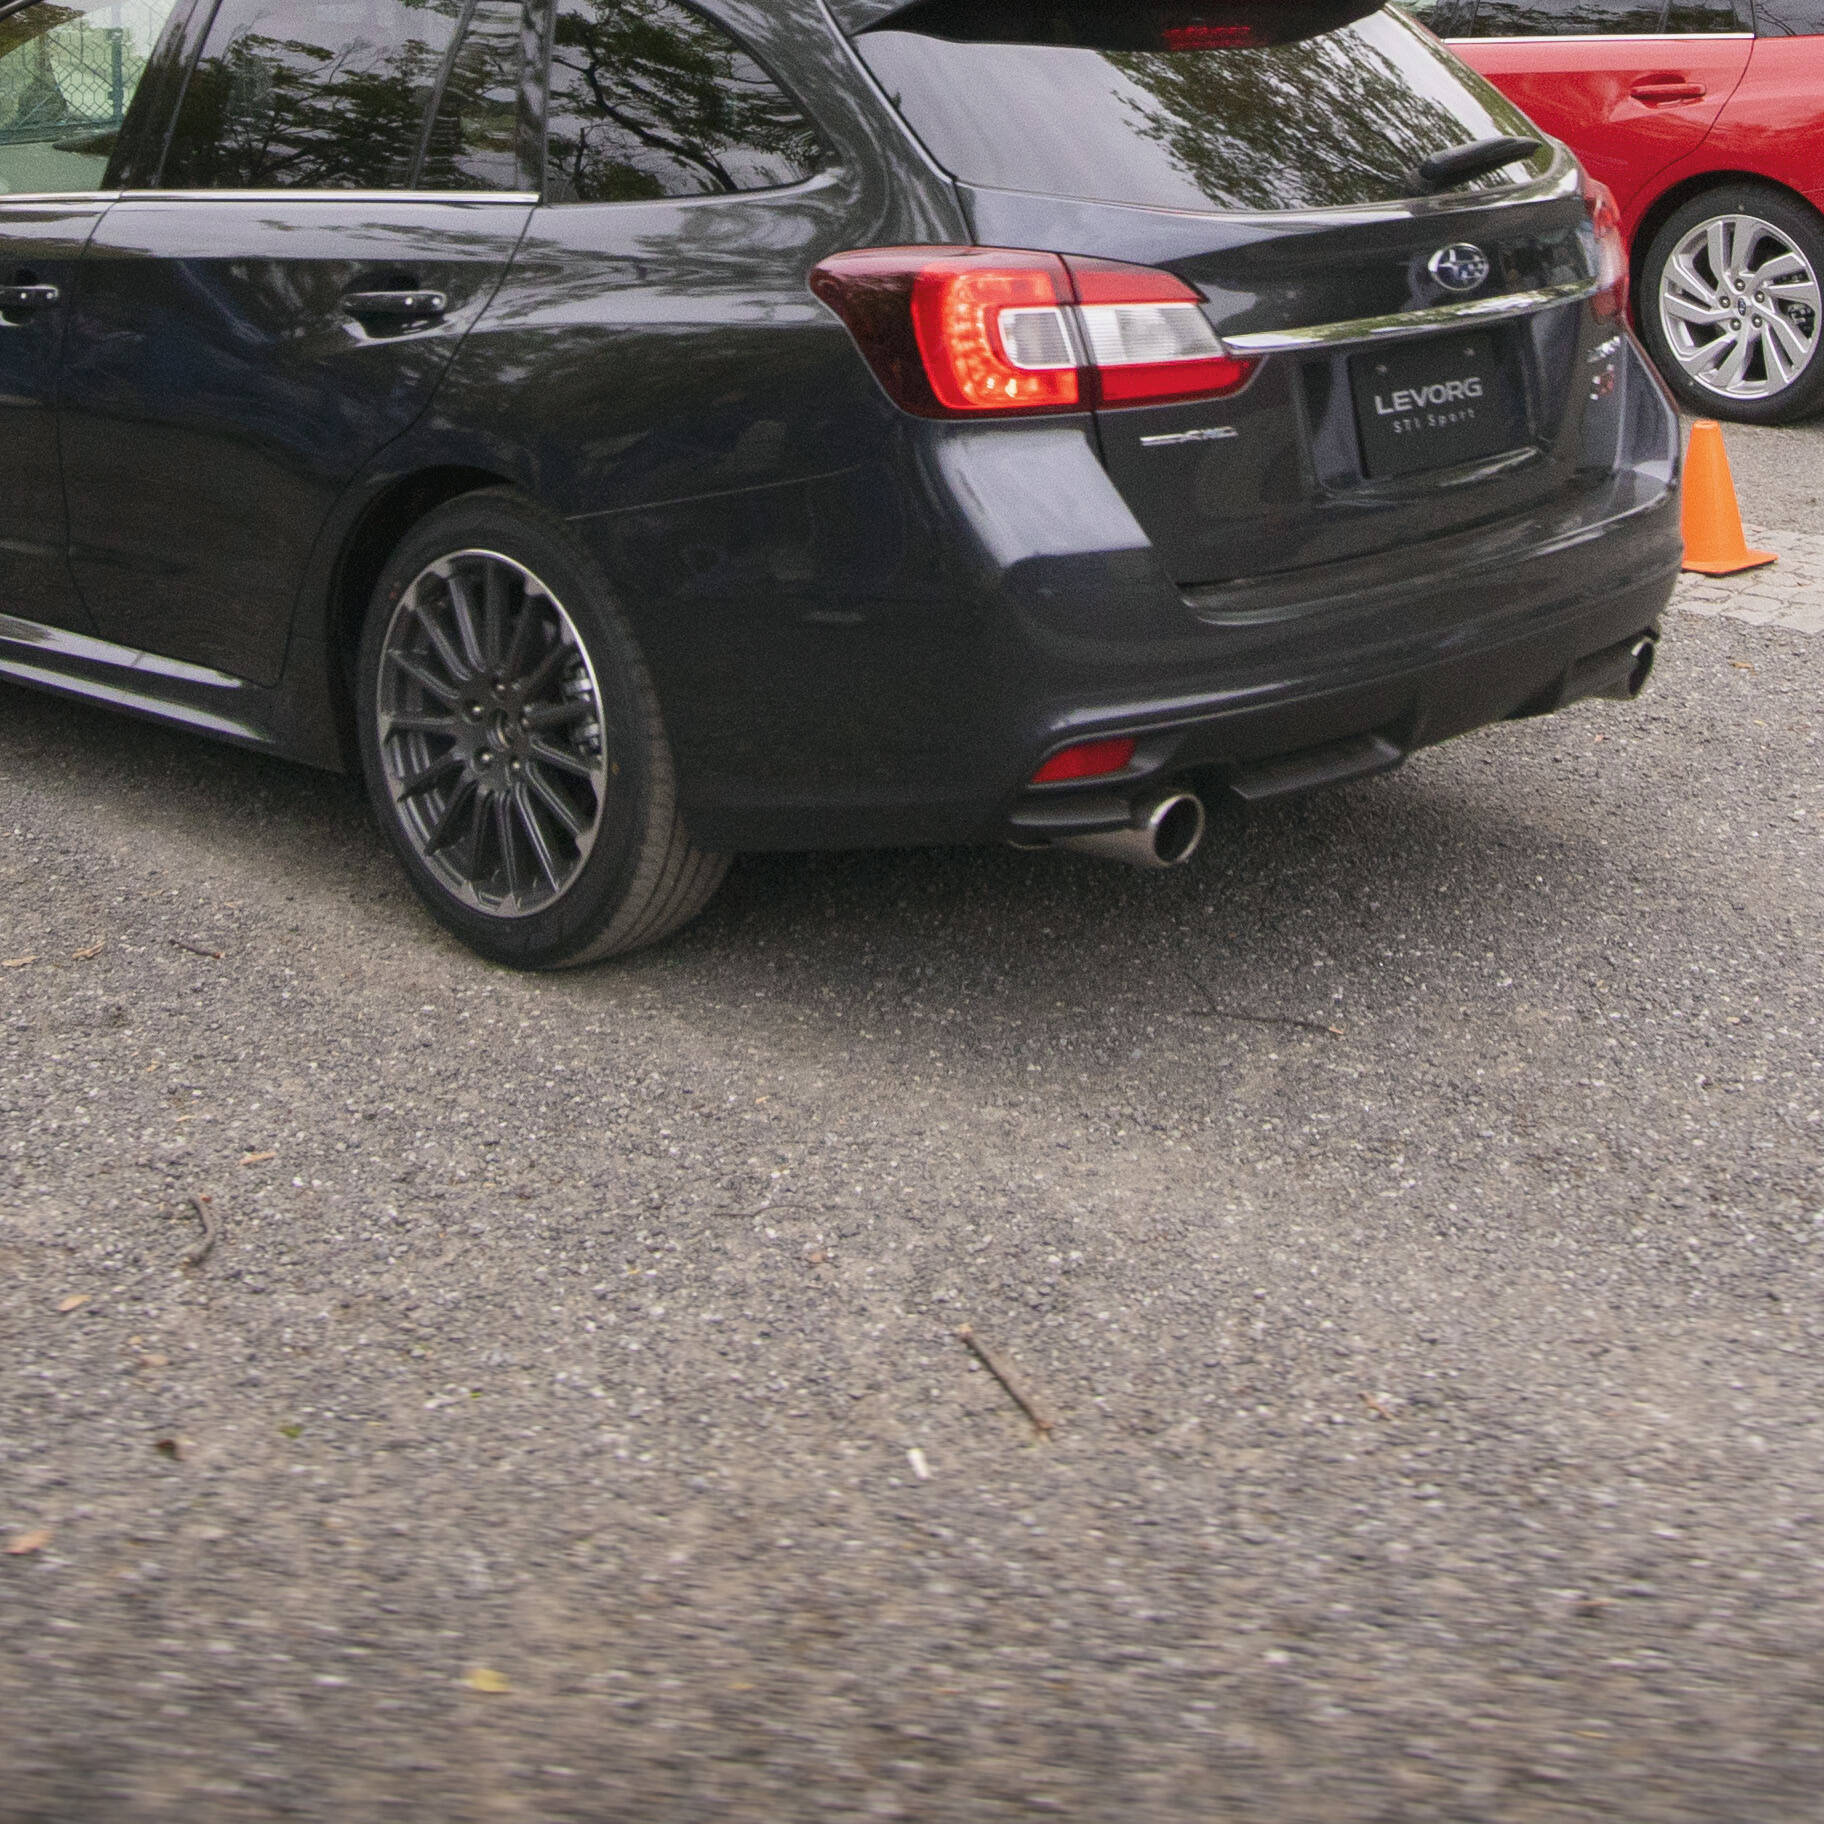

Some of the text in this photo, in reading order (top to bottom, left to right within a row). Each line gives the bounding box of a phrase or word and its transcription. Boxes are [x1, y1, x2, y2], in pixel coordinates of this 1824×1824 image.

[1374, 377, 1484, 416] LEVORG
[1393, 408, 1476, 433] STI Sport
